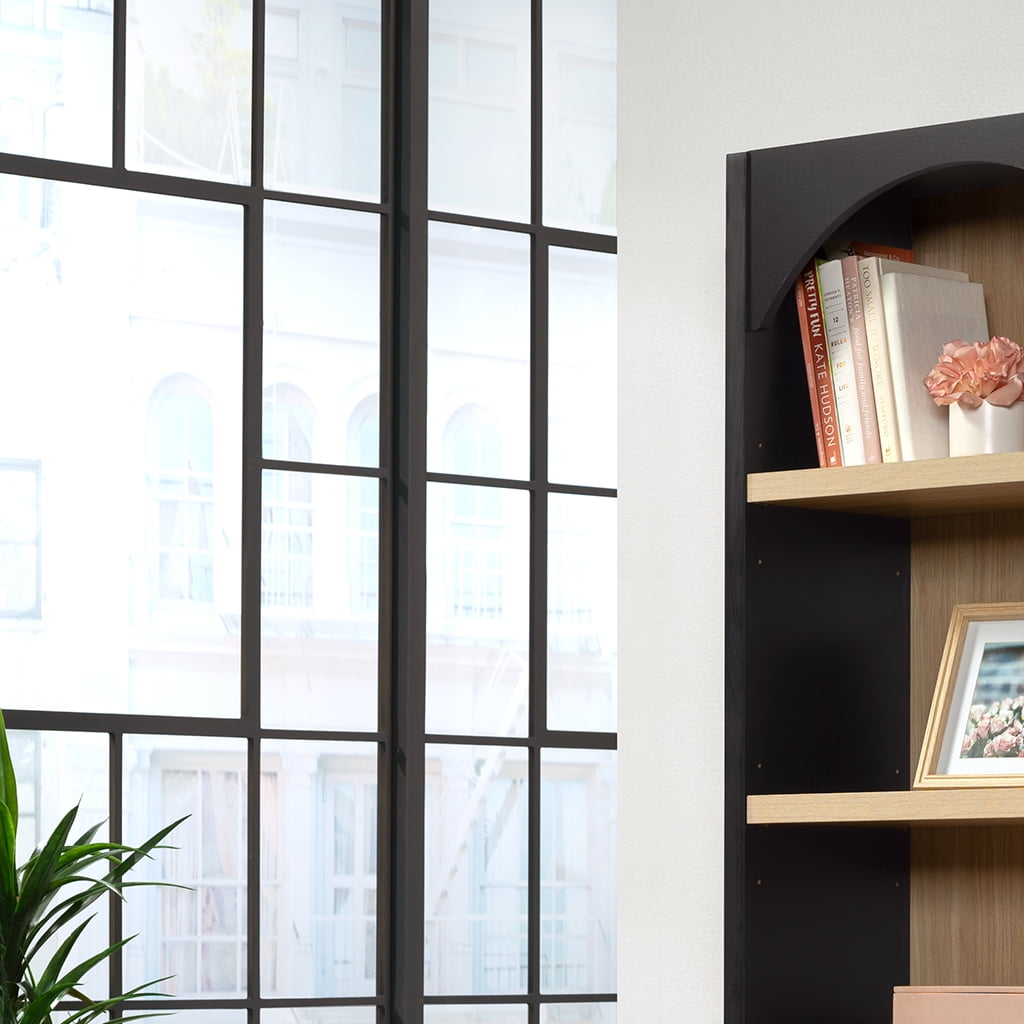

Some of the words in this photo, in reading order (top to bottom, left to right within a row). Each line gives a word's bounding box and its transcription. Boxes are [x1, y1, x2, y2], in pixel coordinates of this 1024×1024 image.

[862, 265, 871, 288] TOO
[851, 278, 861, 320] PATRICIA
[814, 344, 828, 379] KATE
[852, 327, 862, 346] food
[861, 392, 869, 408] and
[819, 385, 836, 447] HUDSON
